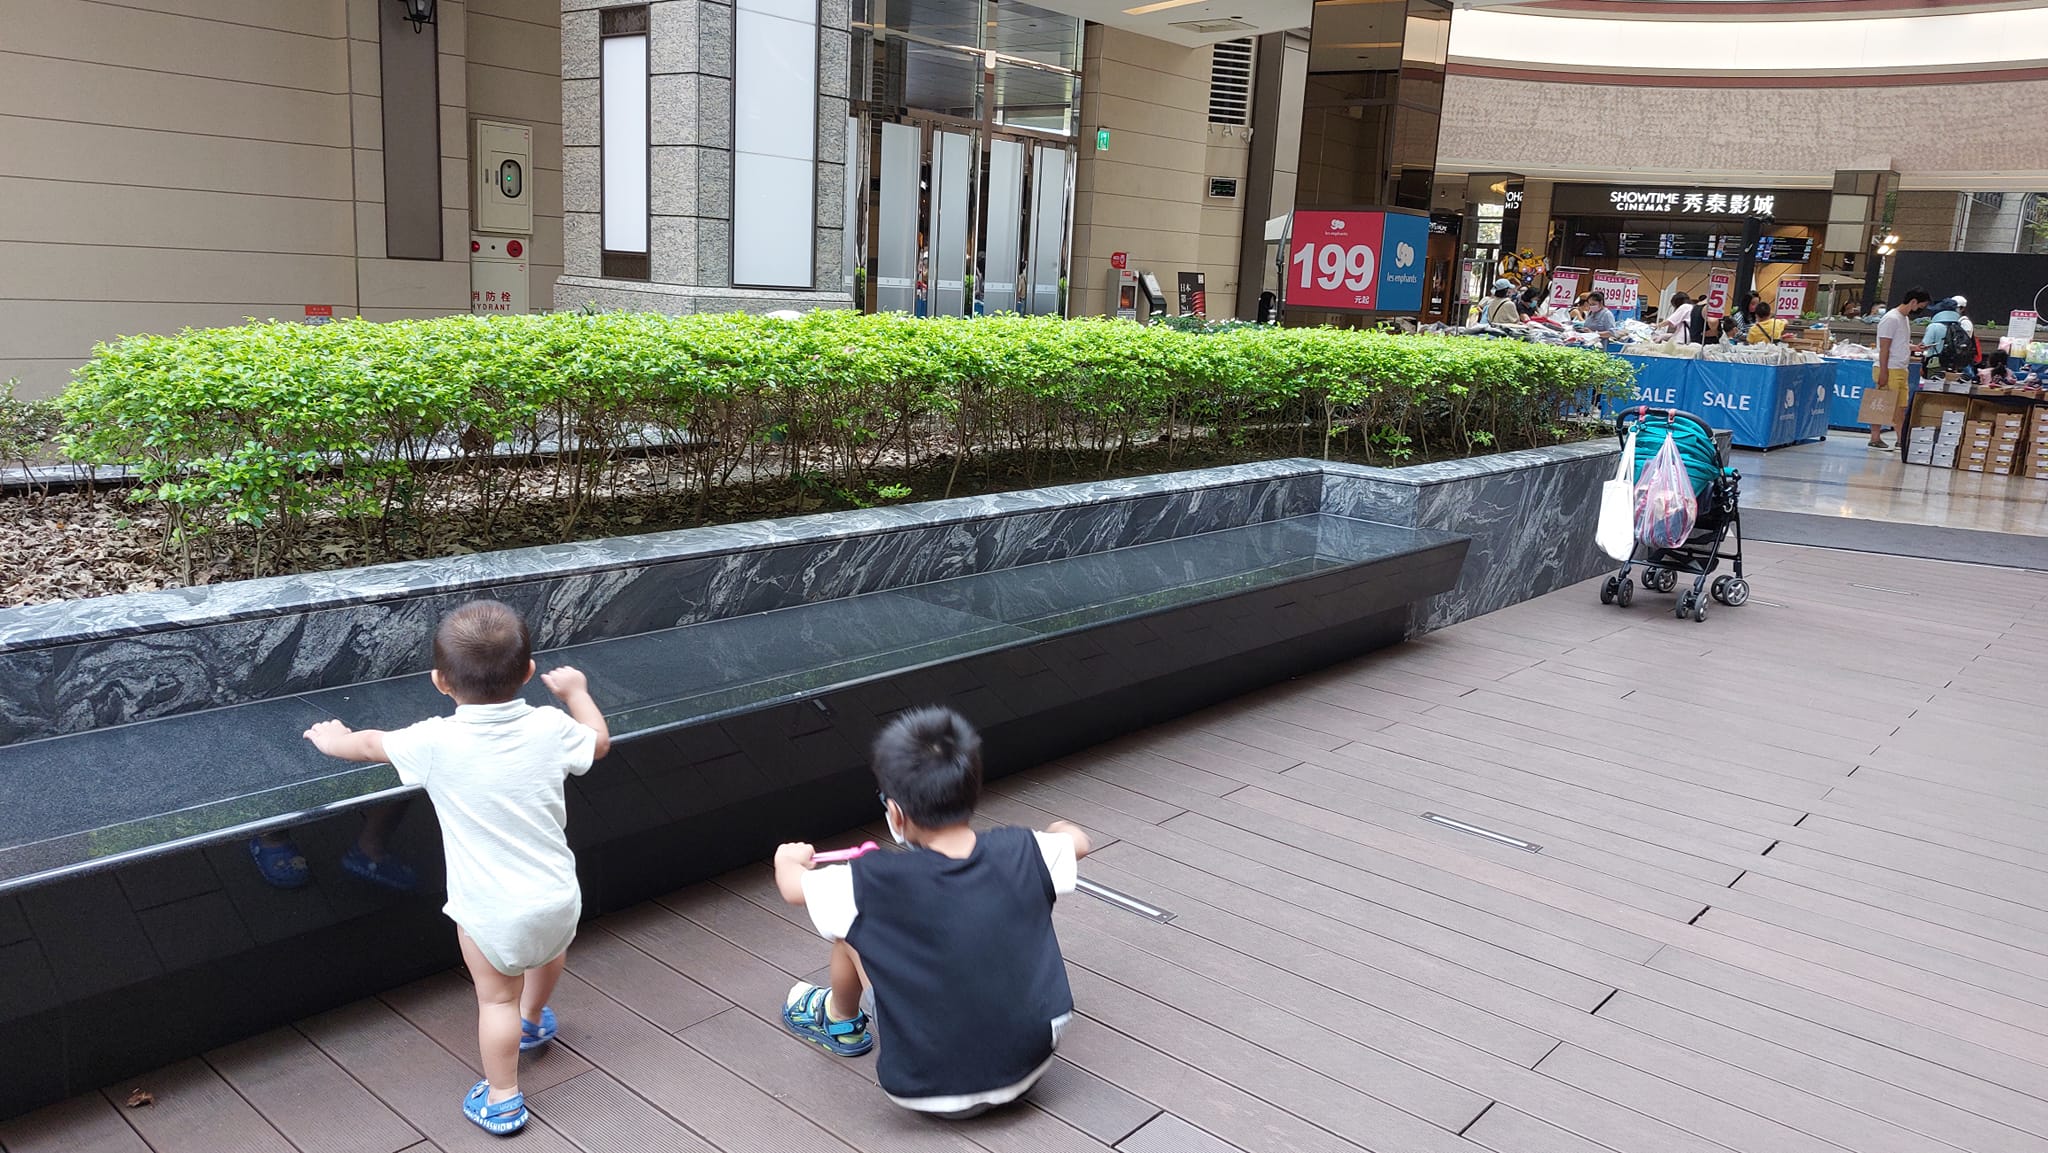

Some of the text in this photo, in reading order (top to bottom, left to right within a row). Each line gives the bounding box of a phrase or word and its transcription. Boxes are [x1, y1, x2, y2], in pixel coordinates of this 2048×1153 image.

[1610, 191, 1679, 204] SHOWTIME
[1682, 193, 1775, 215] 秀泰影城
[1616, 202, 1671, 212] CINEMAS
[1293, 243, 1374, 291] 199
[1354, 295, 1370, 304] 元起
[1709, 290, 1724, 308] 5
[1778, 297, 1798, 310] 299
[472, 303, 511, 311] HYDRANT
[1631, 387, 1677, 404] SALE
[1833, 384, 1862, 399] ALE
[1702, 391, 1751, 411] SALE
